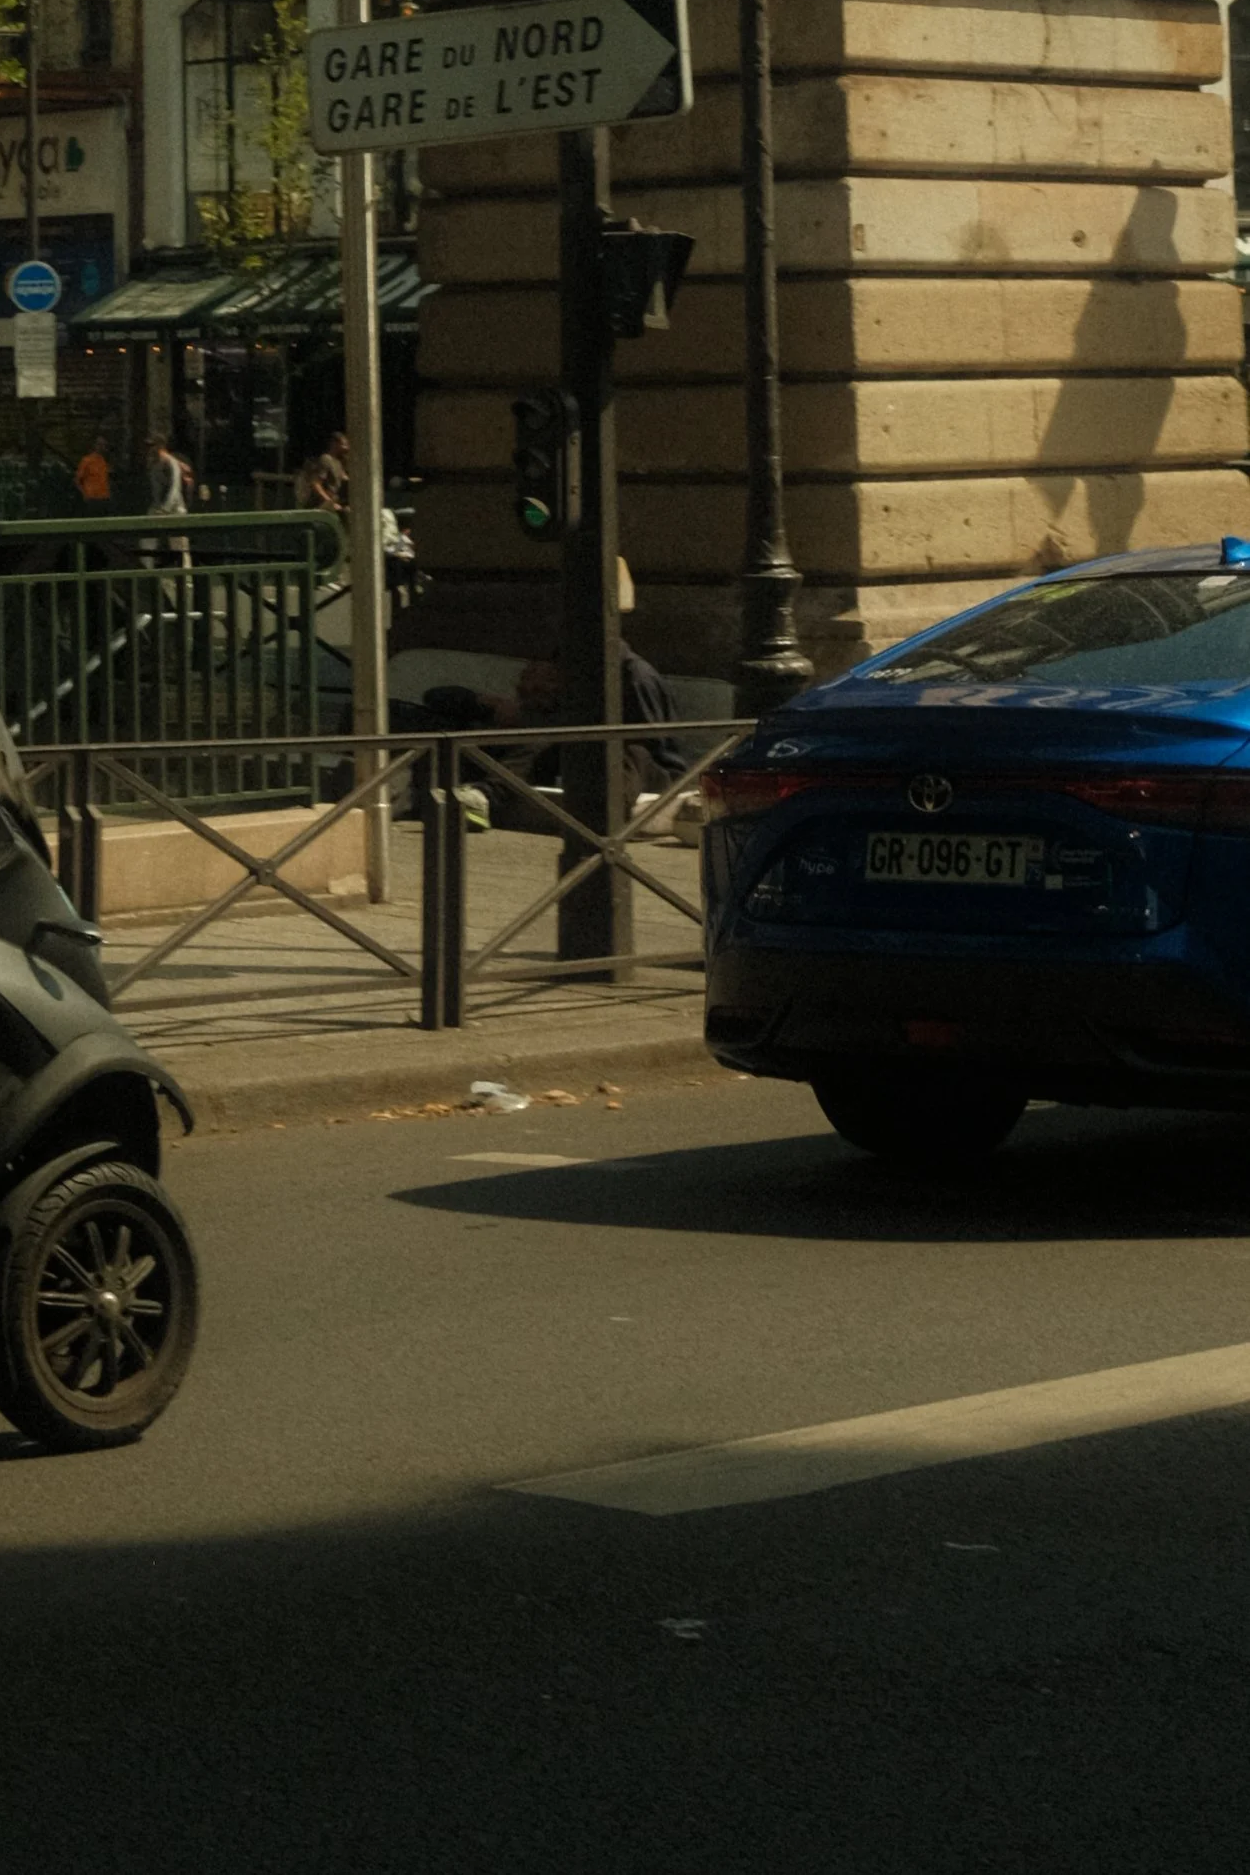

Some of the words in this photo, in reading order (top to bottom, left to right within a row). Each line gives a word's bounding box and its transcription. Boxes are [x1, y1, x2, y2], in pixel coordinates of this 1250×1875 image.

[324, 37, 424, 83] GARE
[442, 44, 475, 69] DU
[494, 16, 603, 63] NORD
[327, 89, 426, 134] GARE
[445, 96, 475, 120] DE
[496, 69, 602, 114] L'EST
[799, 857, 835, 876] hype
[869, 837, 1023, 879] GR-096-GT
